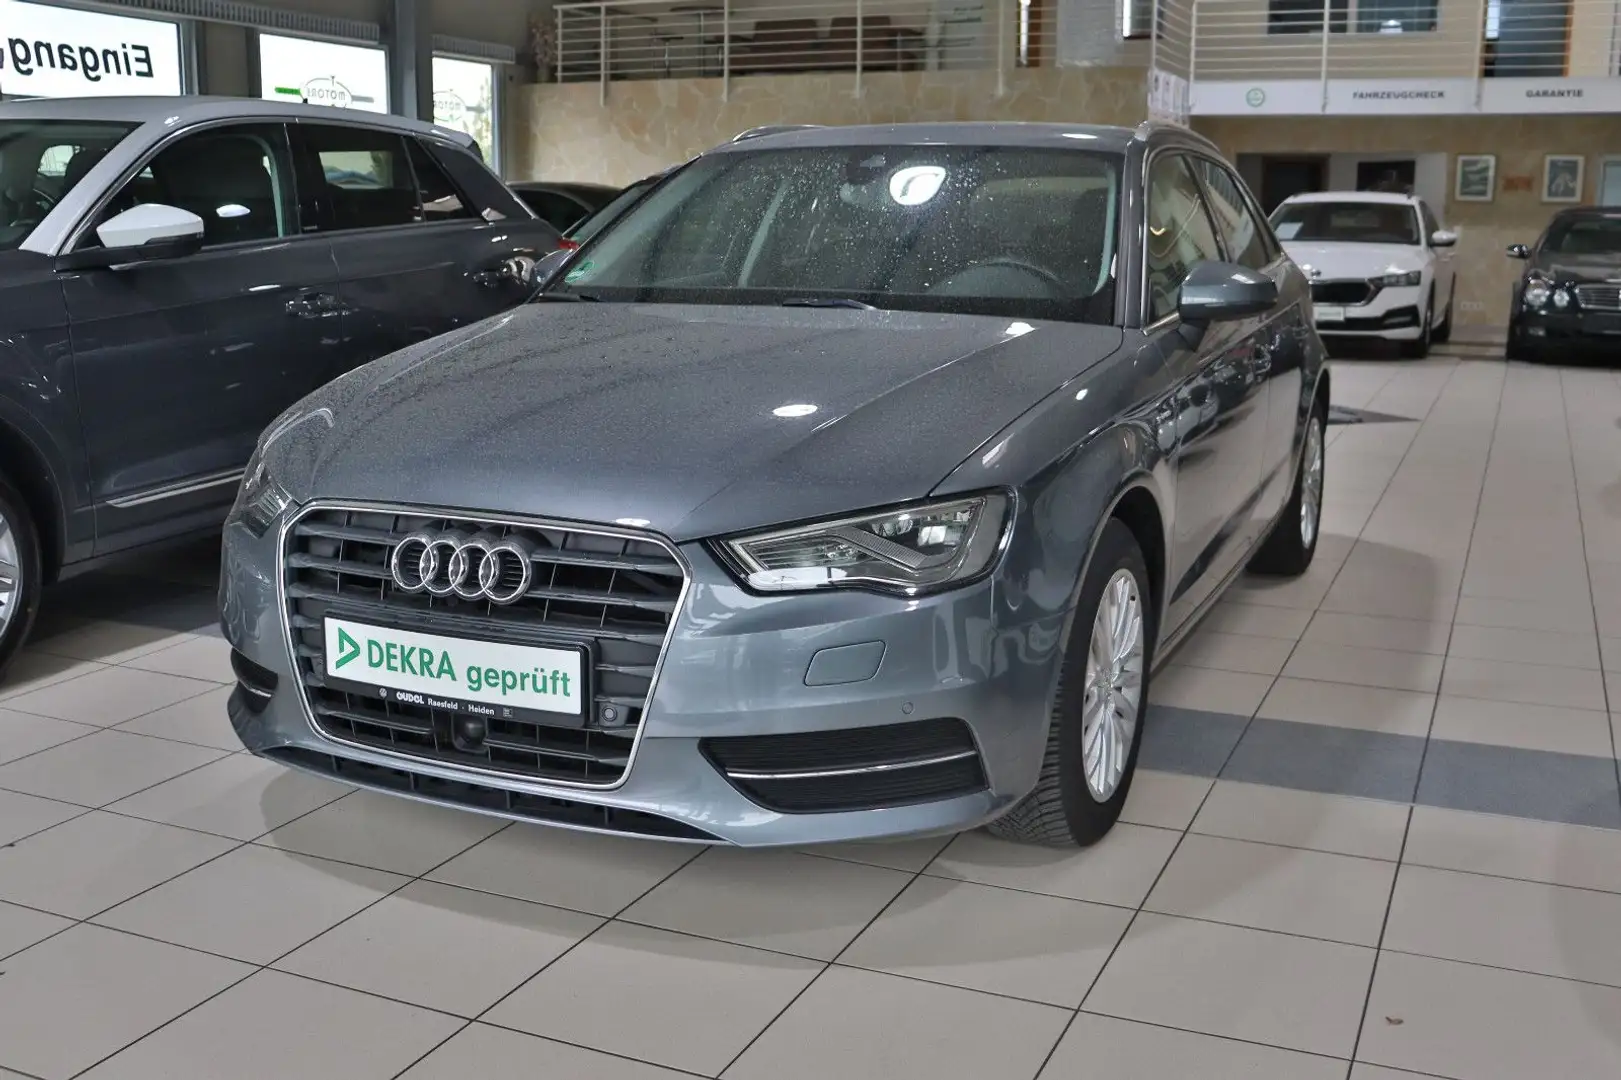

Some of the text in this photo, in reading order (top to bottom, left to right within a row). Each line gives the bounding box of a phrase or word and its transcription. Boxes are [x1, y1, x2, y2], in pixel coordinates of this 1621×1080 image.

[1352, 90, 1445, 100] FAHRZEUGCHECK
[1525, 88, 1584, 98] GARANTIE
[367, 639, 571, 697] DEKRA geprüft
[427, 698, 459, 710] Raesfeld
[468, 704, 495, 716] Heiden
